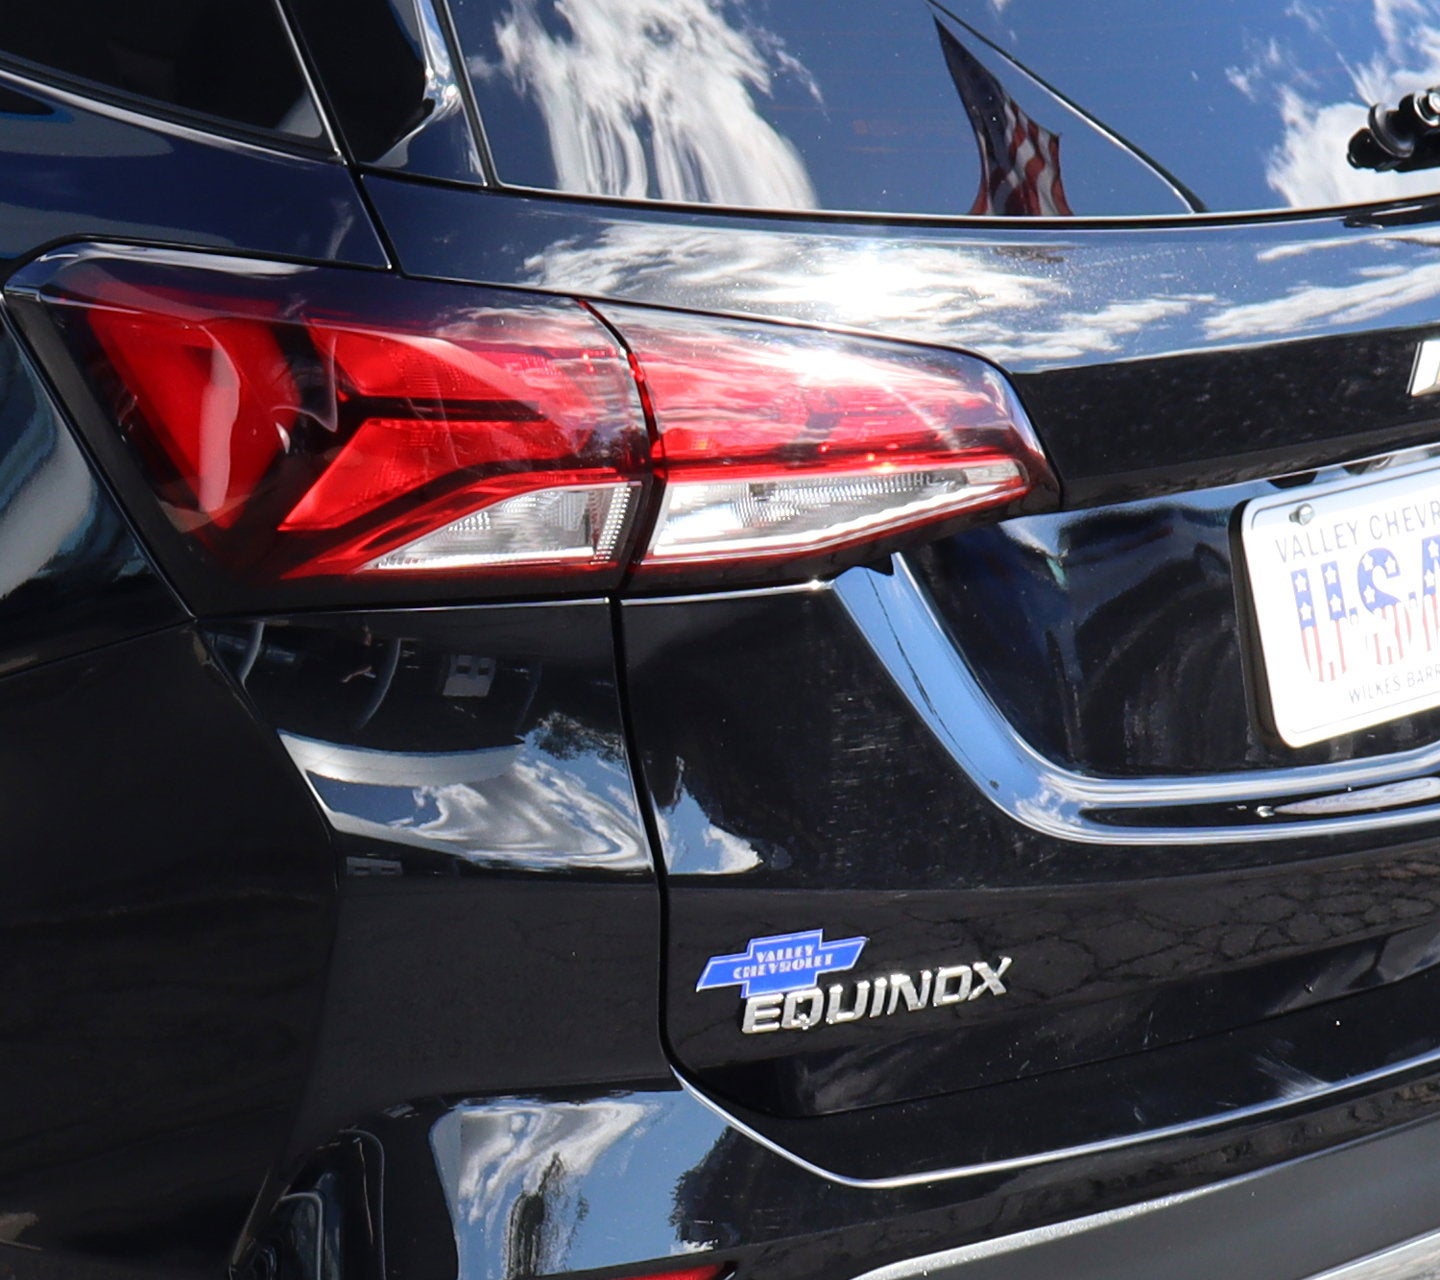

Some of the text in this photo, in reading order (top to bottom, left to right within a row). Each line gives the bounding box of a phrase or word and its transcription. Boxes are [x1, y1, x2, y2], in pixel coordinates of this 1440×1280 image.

[1274, 521, 1360, 563] VALLEY
[1348, 675, 1401, 703] WILKES
[733, 954, 832, 980] CHEVROLET
[756, 944, 815, 963] VALLEY
[742, 956, 1012, 1033] EQUINOX
